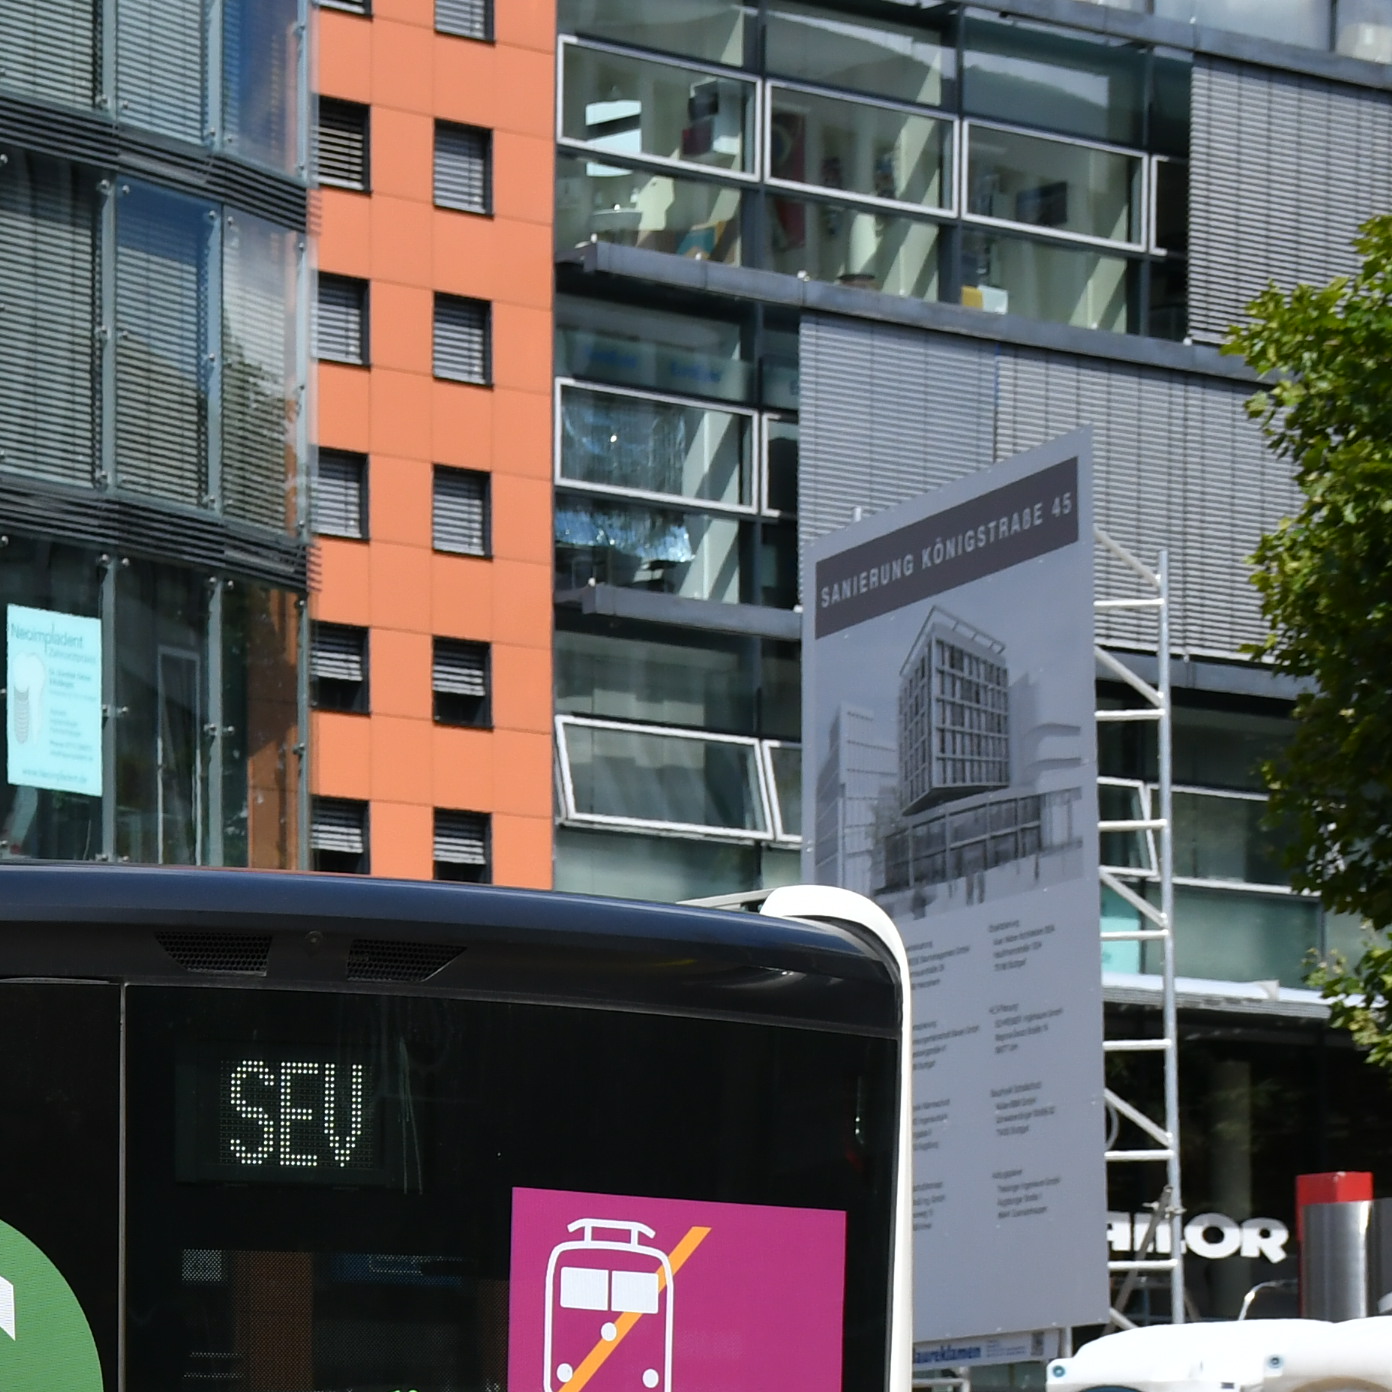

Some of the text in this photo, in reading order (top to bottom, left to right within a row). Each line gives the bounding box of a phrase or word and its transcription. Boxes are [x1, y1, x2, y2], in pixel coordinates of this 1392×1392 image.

[821, 554, 914, 607] SANIERUNG
[1052, 492, 1072, 517] 45
[11, 622, 84, 654] Neoimpladent
[229, 1060, 363, 1167] SEV
